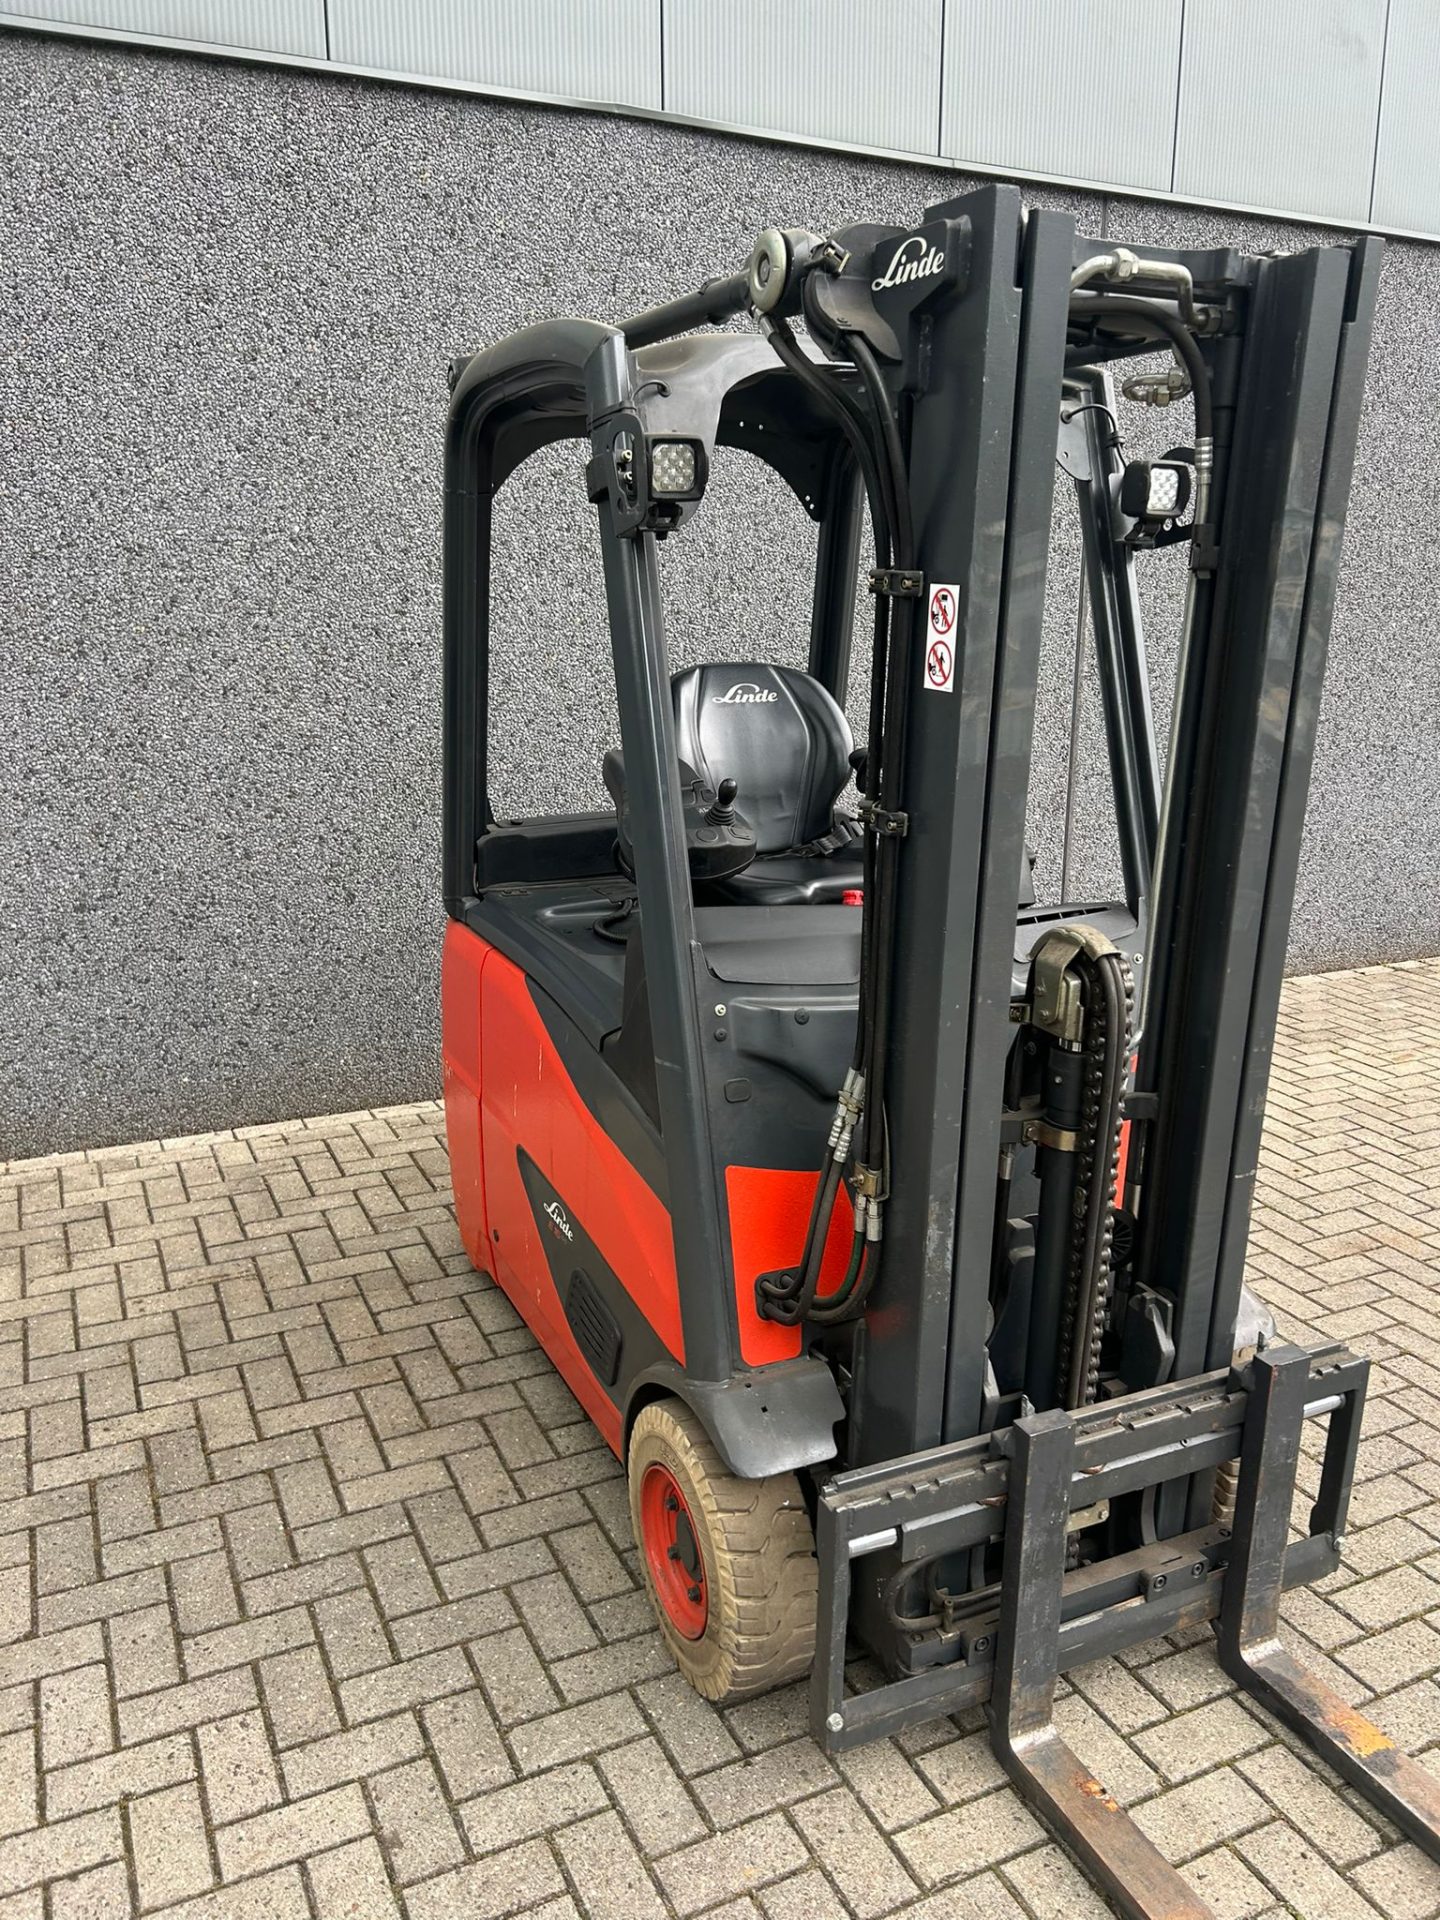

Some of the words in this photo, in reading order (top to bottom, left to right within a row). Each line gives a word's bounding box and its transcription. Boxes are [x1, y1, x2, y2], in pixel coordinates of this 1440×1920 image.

[871, 236, 945, 292] Linde
[711, 682, 779, 704] Linde
[543, 1201, 574, 1242] Linde
